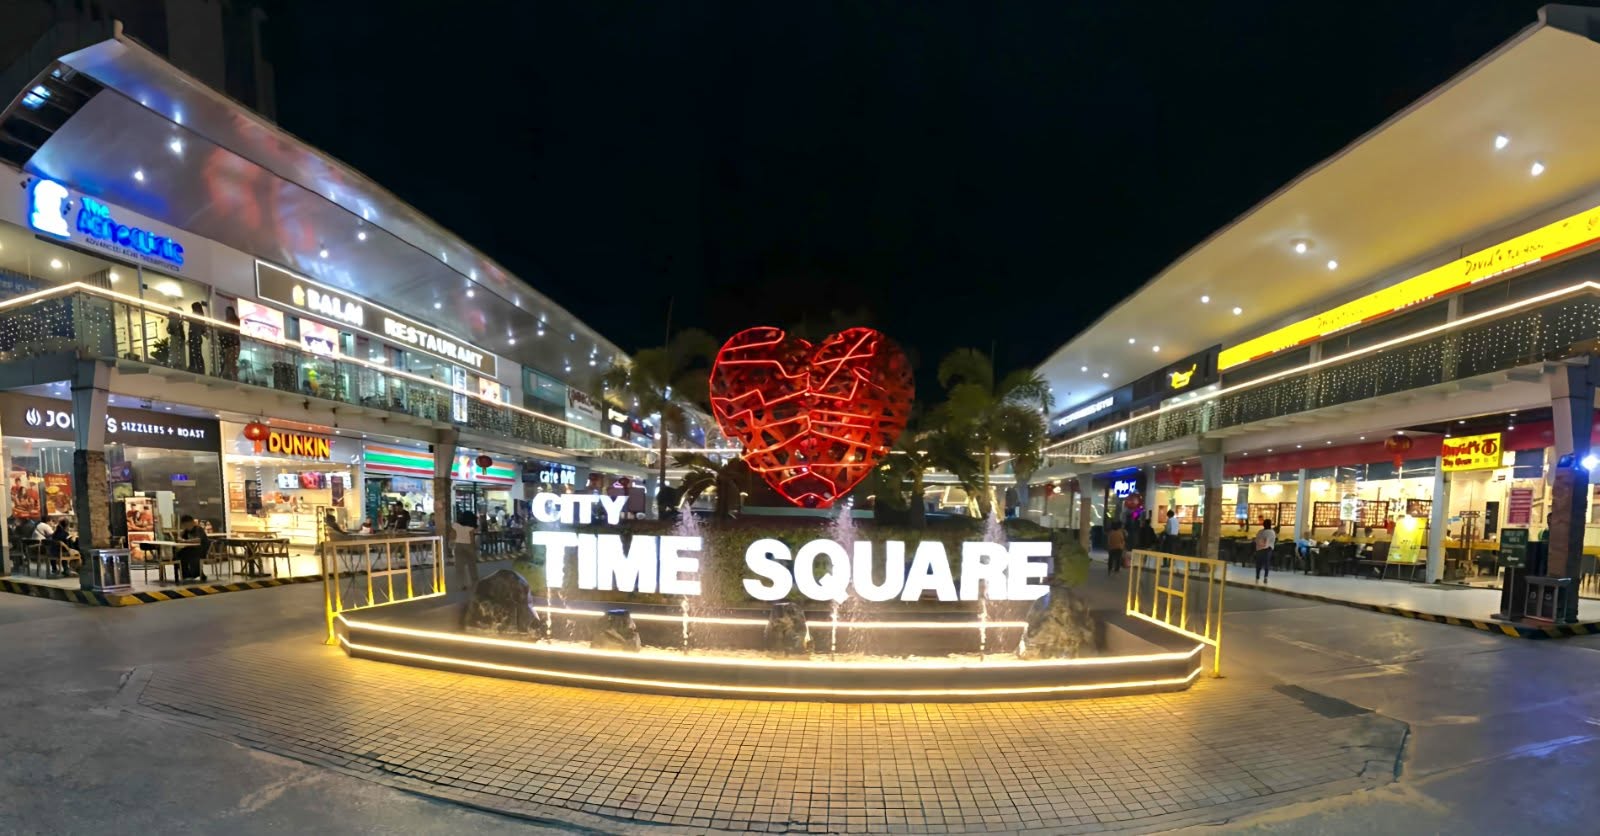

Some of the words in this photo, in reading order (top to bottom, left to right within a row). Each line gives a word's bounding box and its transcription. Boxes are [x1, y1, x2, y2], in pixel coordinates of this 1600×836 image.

[384, 317, 483, 367] RESTAURANT
[121, 421, 165, 435] SIZZLERS
[177, 427, 205, 439] ROAST
[532, 492, 629, 525] CITY
[532, 531, 702, 596] TIME
[743, 538, 1052, 602] SQUARE
